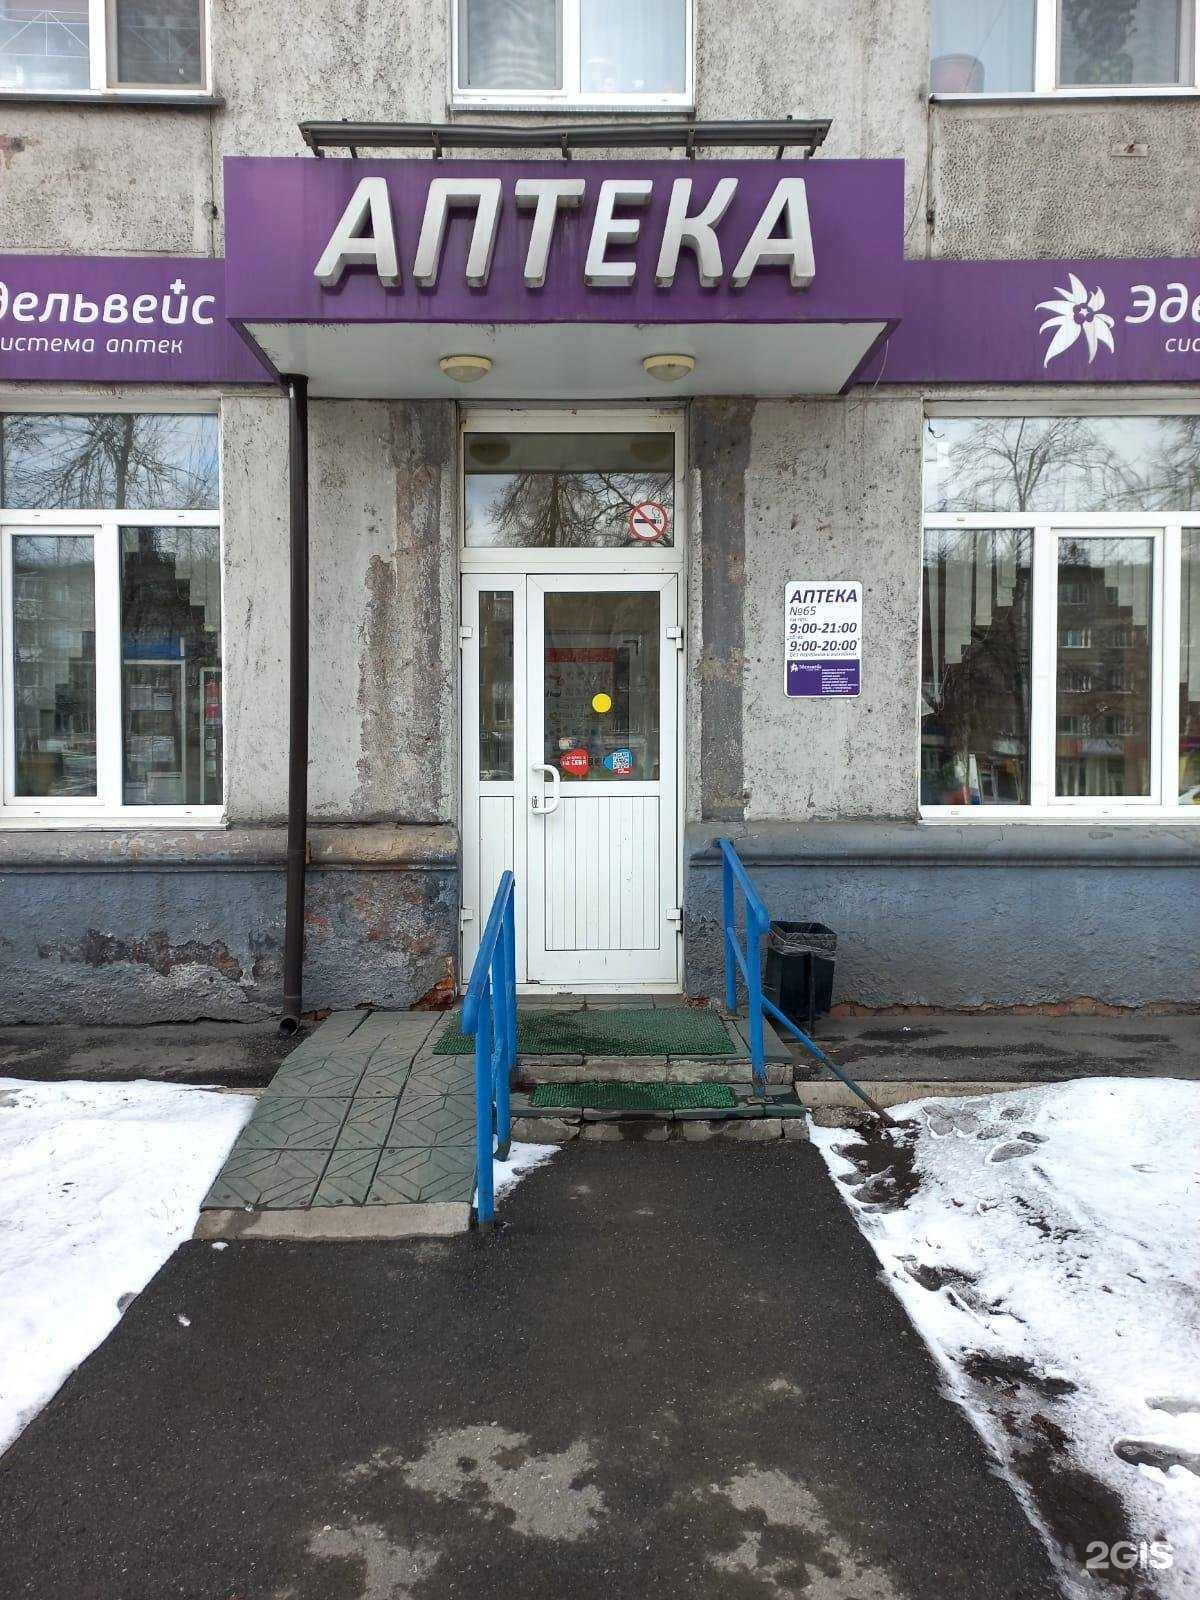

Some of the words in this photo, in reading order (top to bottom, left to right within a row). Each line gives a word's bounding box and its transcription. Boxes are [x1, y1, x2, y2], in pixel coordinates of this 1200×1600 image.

[312, 176, 817, 288] АПТЕКА
[106, 337, 183, 354] аптек
[790, 589, 857, 603] АПТЕКА
[789, 606, 816, 615] №65
[789, 623, 857, 633] 9:00-21:00
[789, 640, 857, 651] 9:00-20:00
